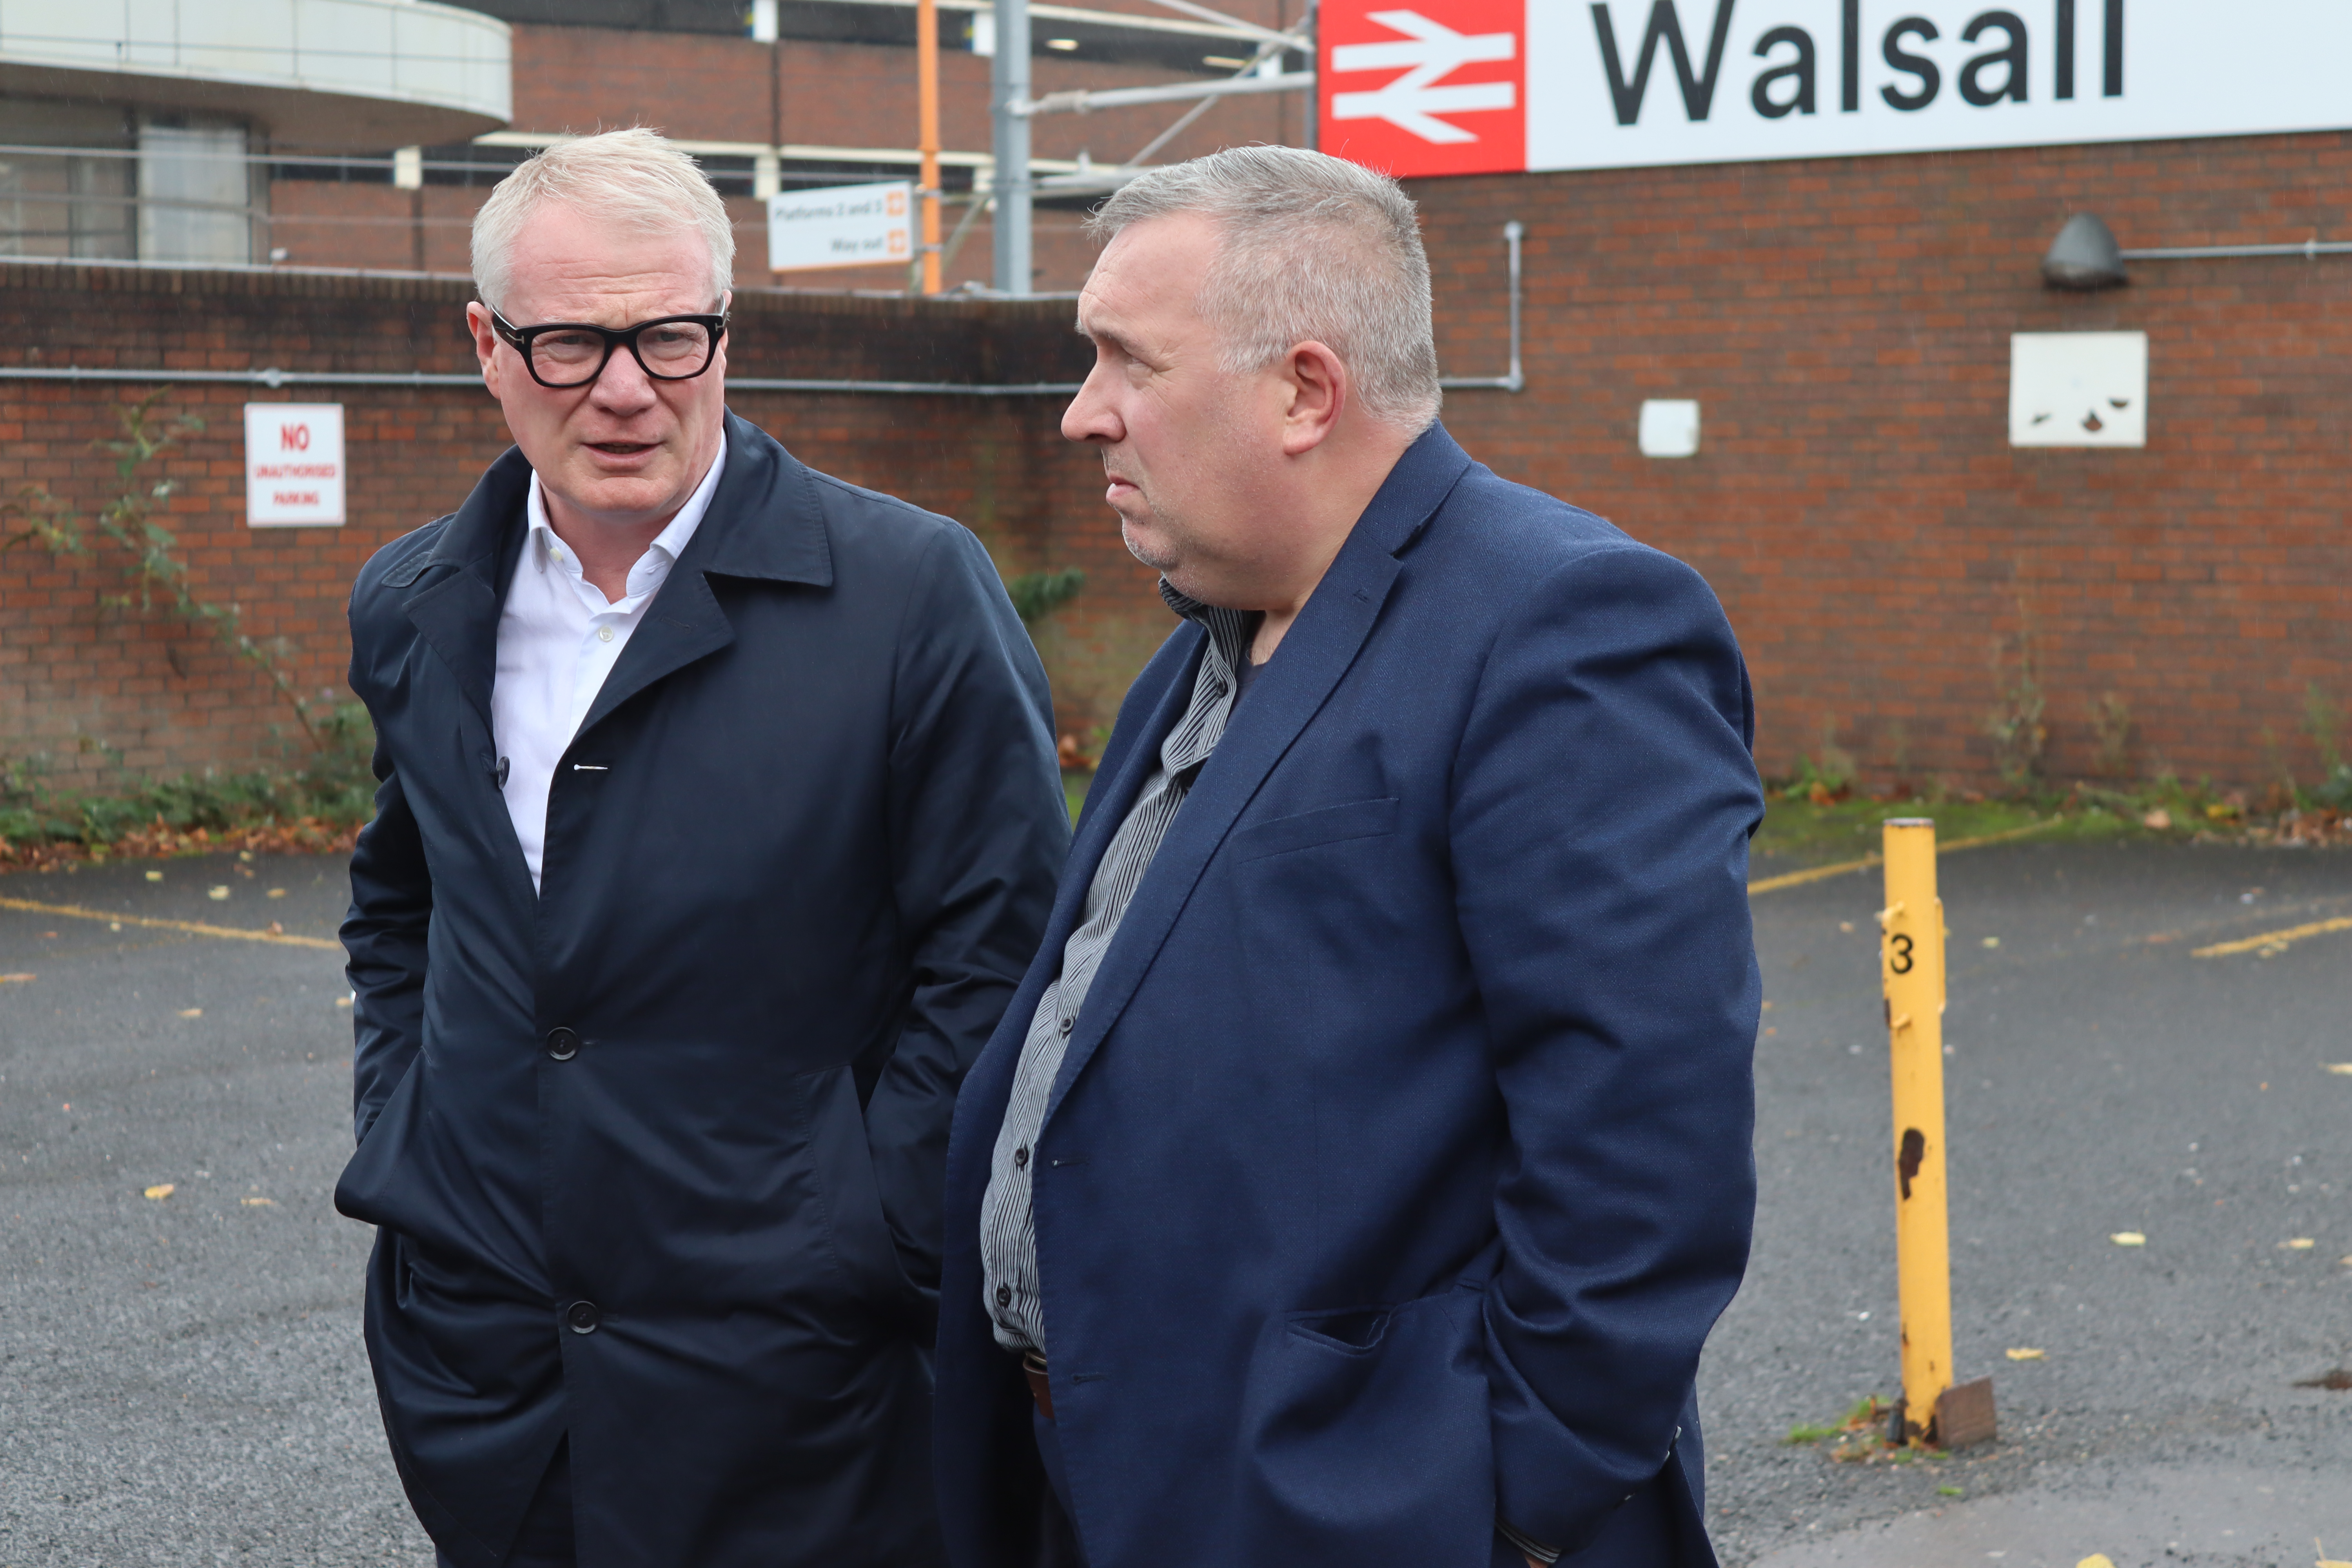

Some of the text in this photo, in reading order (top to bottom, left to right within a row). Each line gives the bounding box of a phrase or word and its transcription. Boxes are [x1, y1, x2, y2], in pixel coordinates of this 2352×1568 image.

[1590, 0, 2124, 125] Walsall
[775, 205, 833, 222] Platforms
[837, 201, 844, 217] 2
[849, 200, 871, 215] and
[830, 237, 883, 253] Way out
[281, 423, 310, 451] NO
[274, 492, 319, 505] PARKING
[1891, 933, 1913, 975] 3
